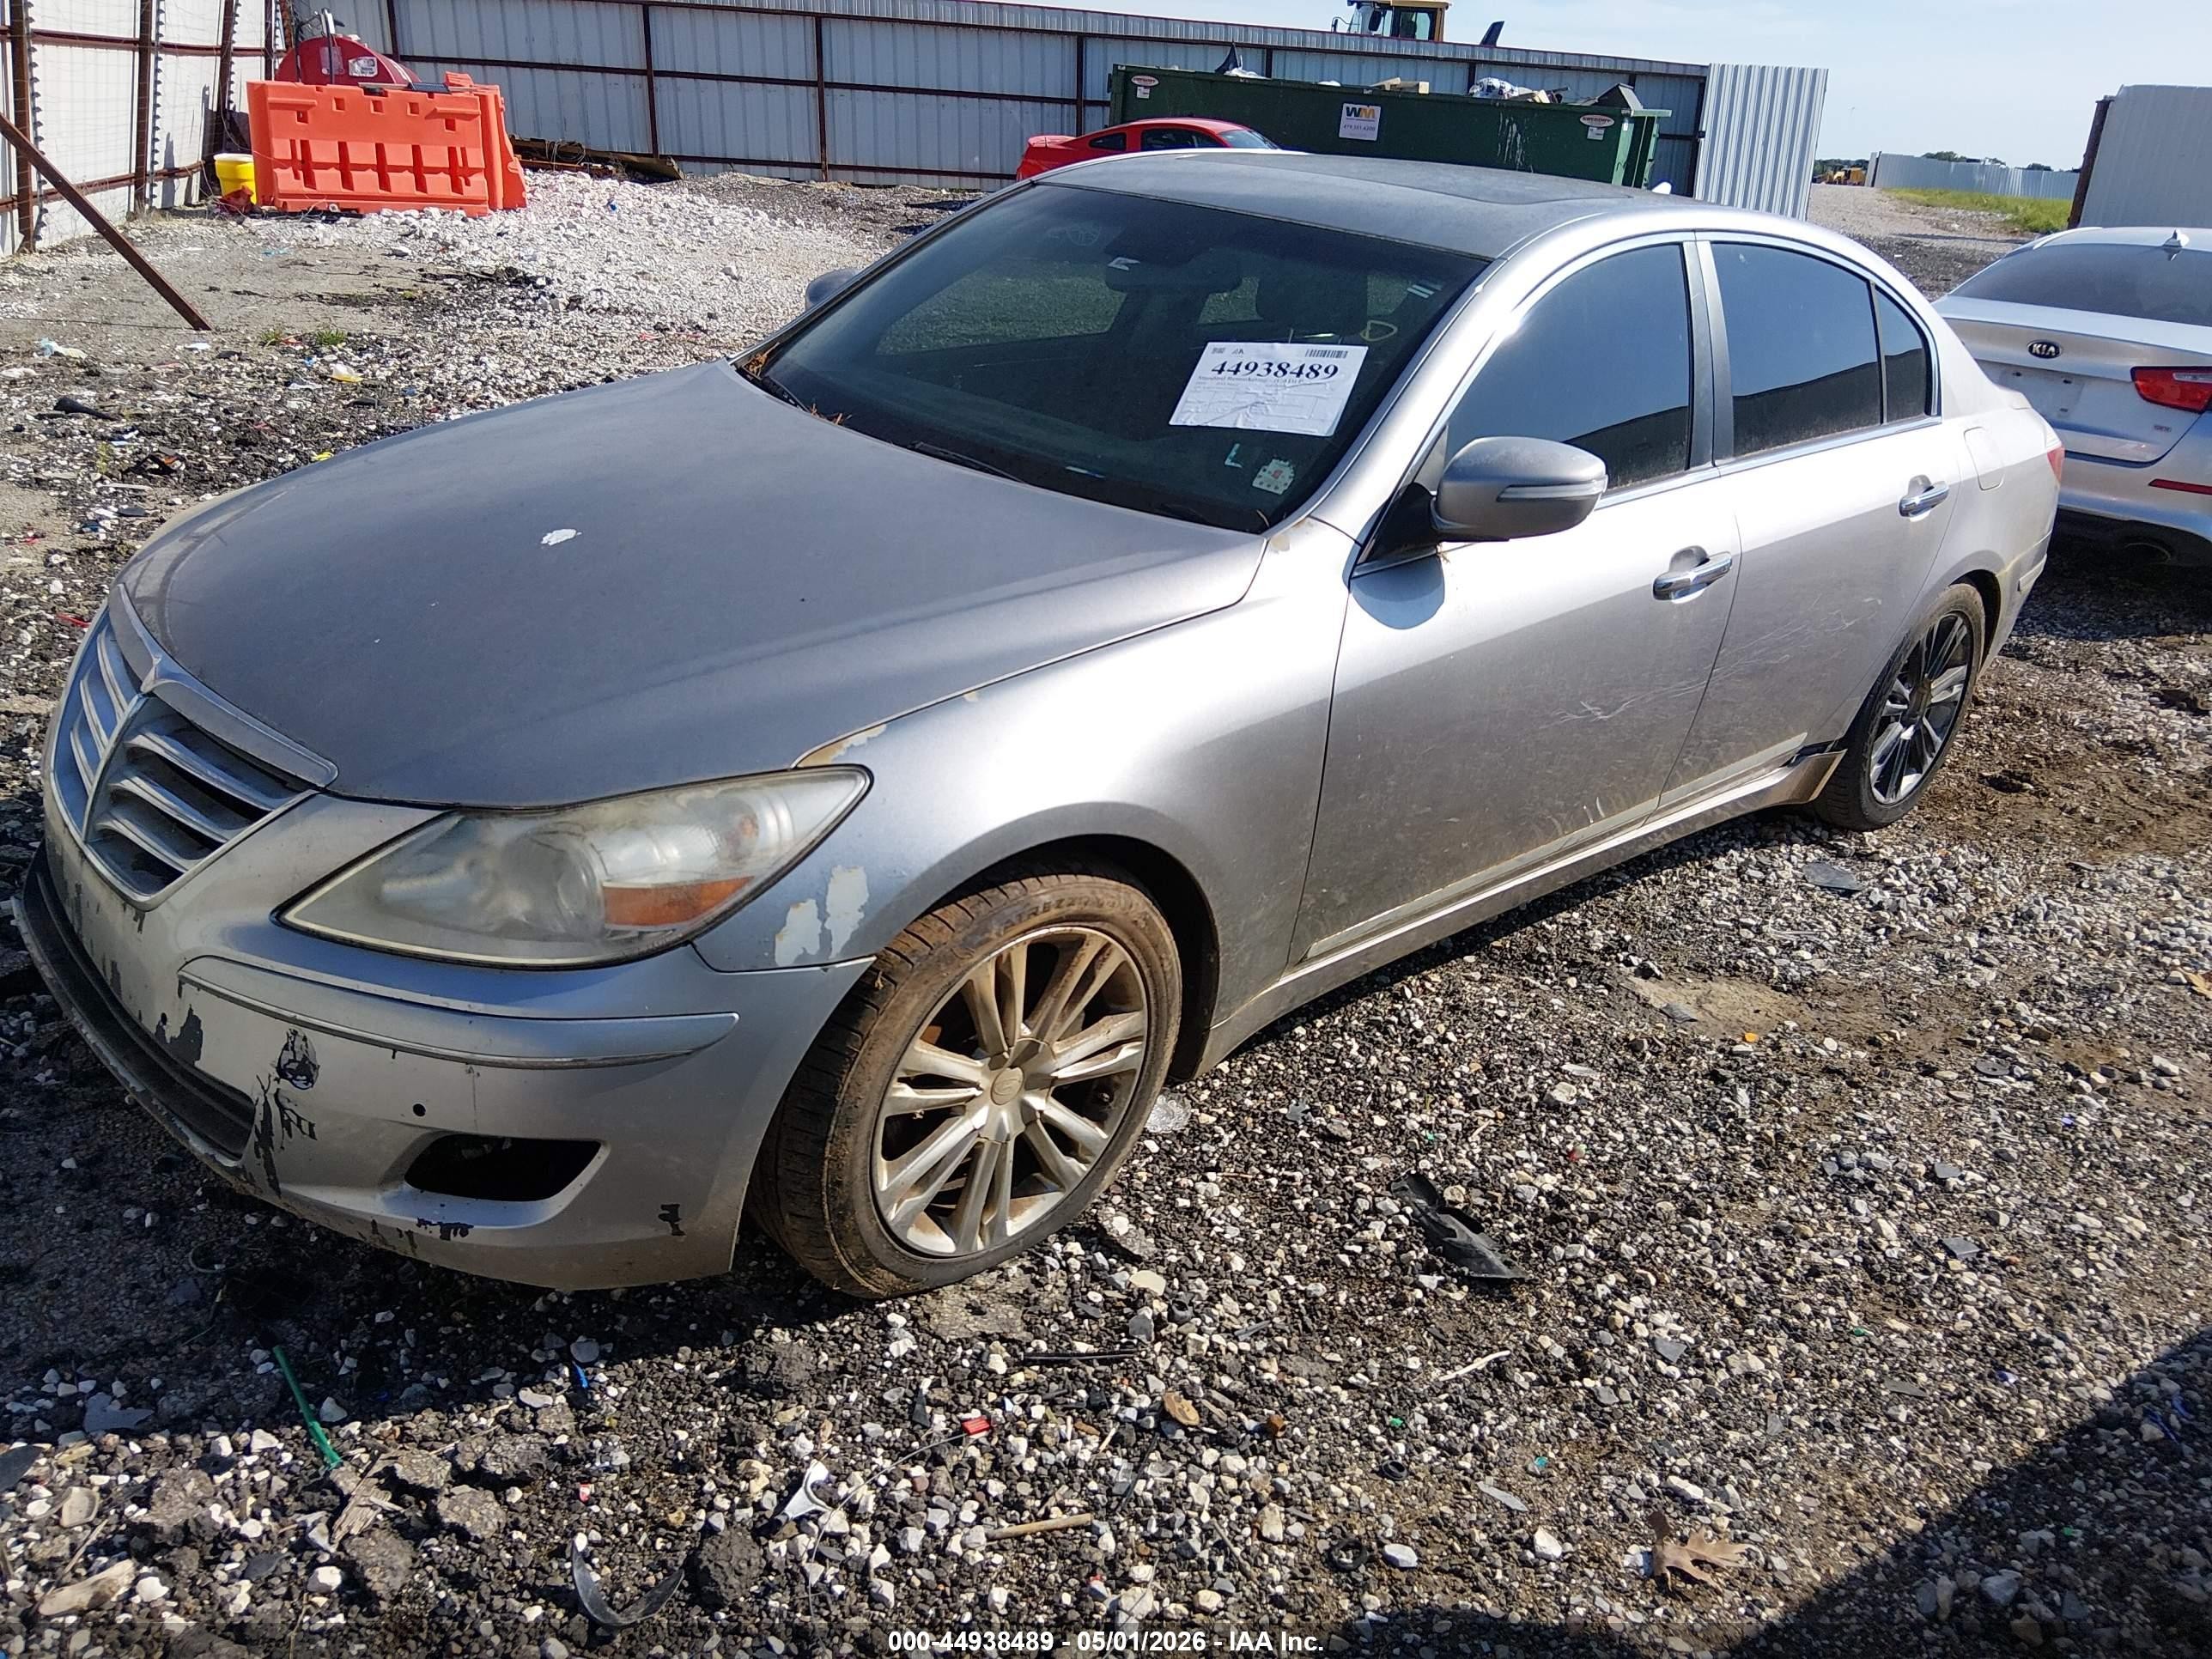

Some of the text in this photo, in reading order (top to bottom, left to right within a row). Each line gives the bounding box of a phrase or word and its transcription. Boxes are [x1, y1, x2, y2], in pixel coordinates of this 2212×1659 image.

[1346, 106, 1376, 118] WM
[2032, 343, 2056, 356] KIA
[1211, 360, 1339, 379] 44938489
